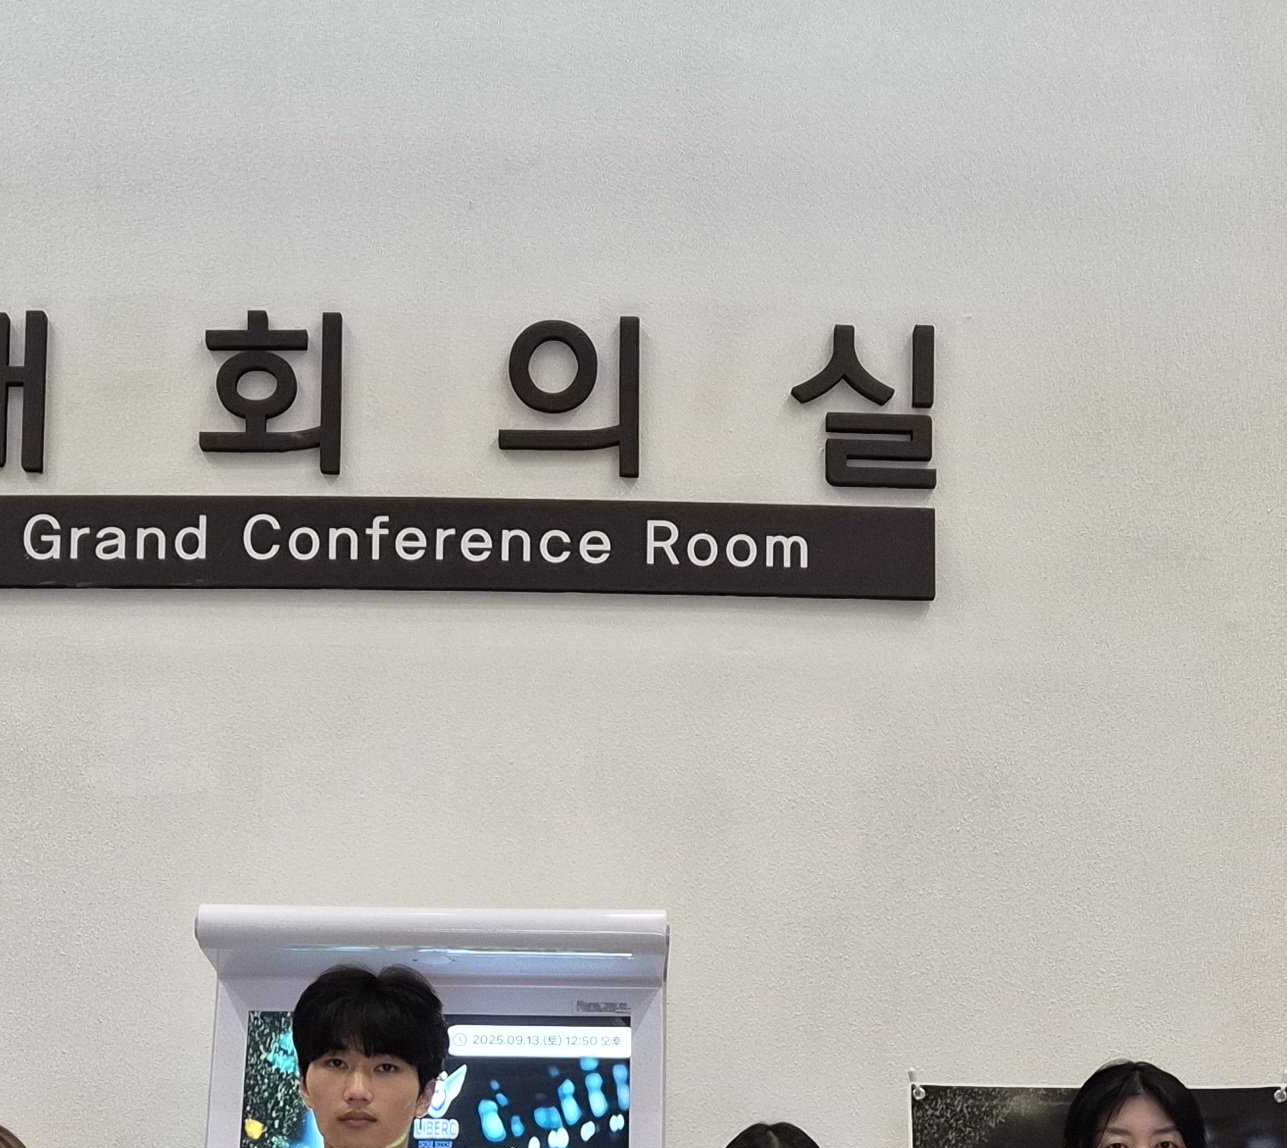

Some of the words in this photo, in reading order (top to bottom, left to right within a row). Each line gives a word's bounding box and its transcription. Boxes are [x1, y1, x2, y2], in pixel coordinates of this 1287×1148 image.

[24, 514, 209, 561] Grand
[242, 515, 613, 565] Conference
[646, 520, 811, 570] Room
[472, 1033, 562, 1047] 2025.09.13.(토)
[566, 1035, 598, 1046] 12:50
[601, 1036, 622, 1047] 오후
[414, 1118, 459, 1139] LIBERO
